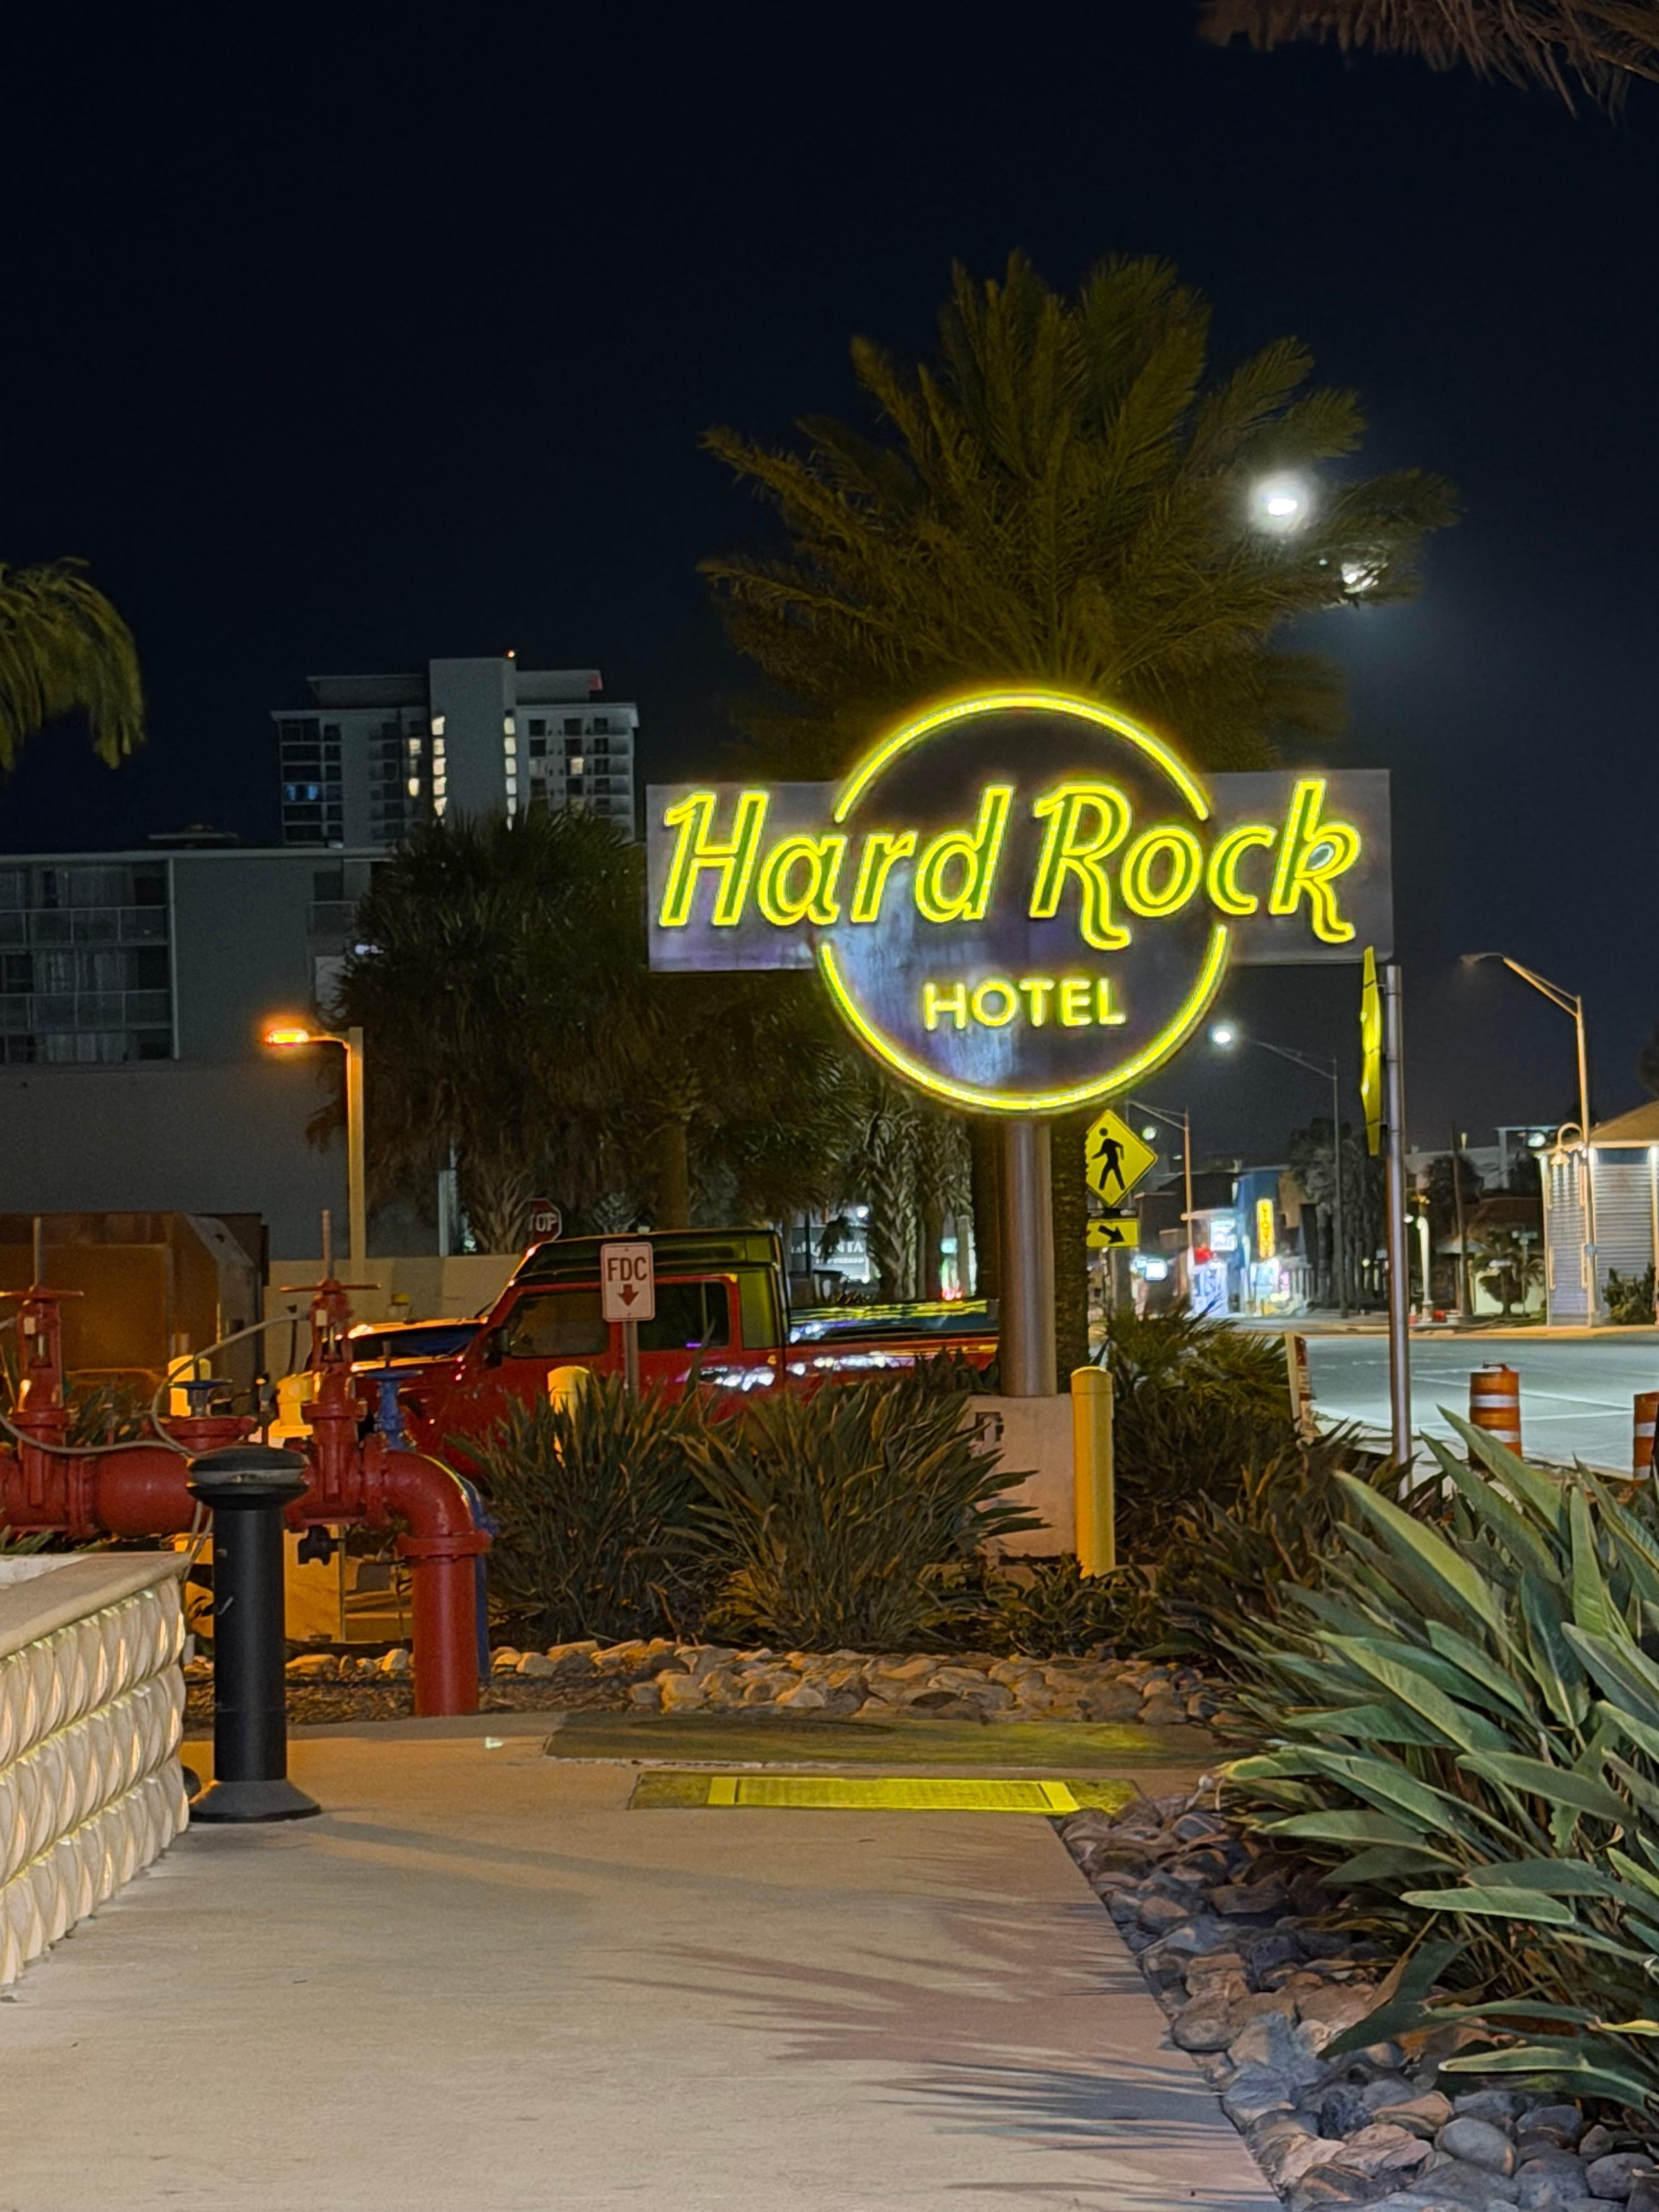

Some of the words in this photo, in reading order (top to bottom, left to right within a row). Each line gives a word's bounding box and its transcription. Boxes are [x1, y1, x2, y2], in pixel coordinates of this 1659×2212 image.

[659, 785, 1014, 927] Hard
[1029, 778, 1362, 950] Rock
[923, 978, 1127, 1030] HOTEL
[528, 1211, 558, 1232] TOP
[607, 1256, 647, 1282] FDC
